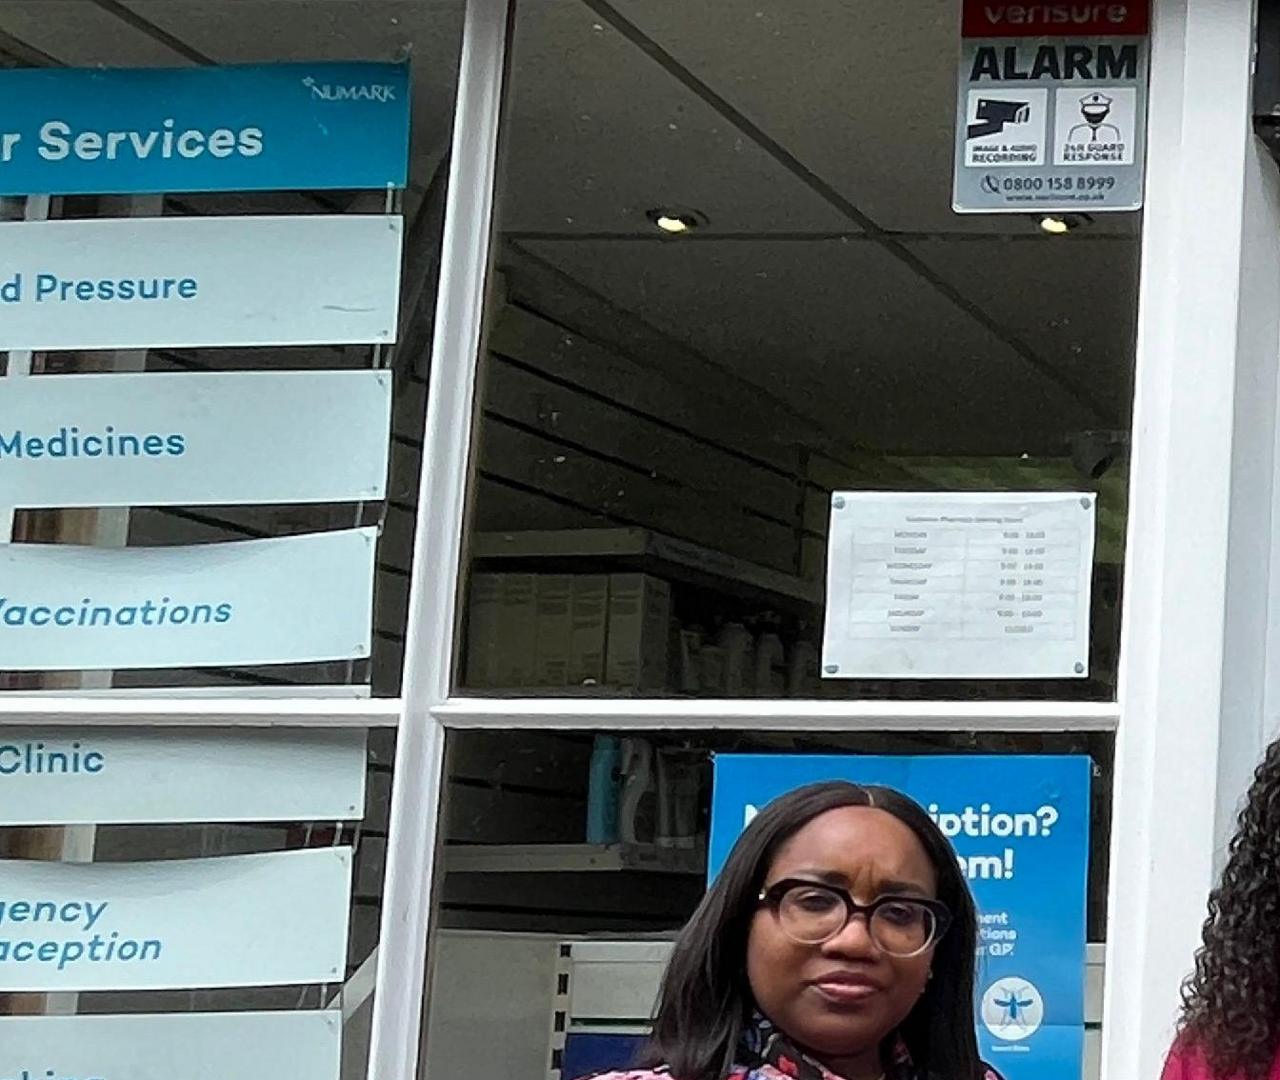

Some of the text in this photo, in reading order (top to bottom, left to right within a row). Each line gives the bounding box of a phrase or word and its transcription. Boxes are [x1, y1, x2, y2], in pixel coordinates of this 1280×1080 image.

[983, 3, 1128, 25] verisure
[970, 45, 1138, 81] ALARM
[311, 85, 396, 102] NUMARK
[38, 118, 263, 161] Services
[972, 153, 1037, 163] RECORDING
[1064, 153, 1124, 162] RESPONSE
[1003, 176, 1115, 190] 0800 158 8999
[36, 274, 198, 302] Pressure
[0, 425, 186, 458] Medicines
[0, 742, 105, 774] Clinic
